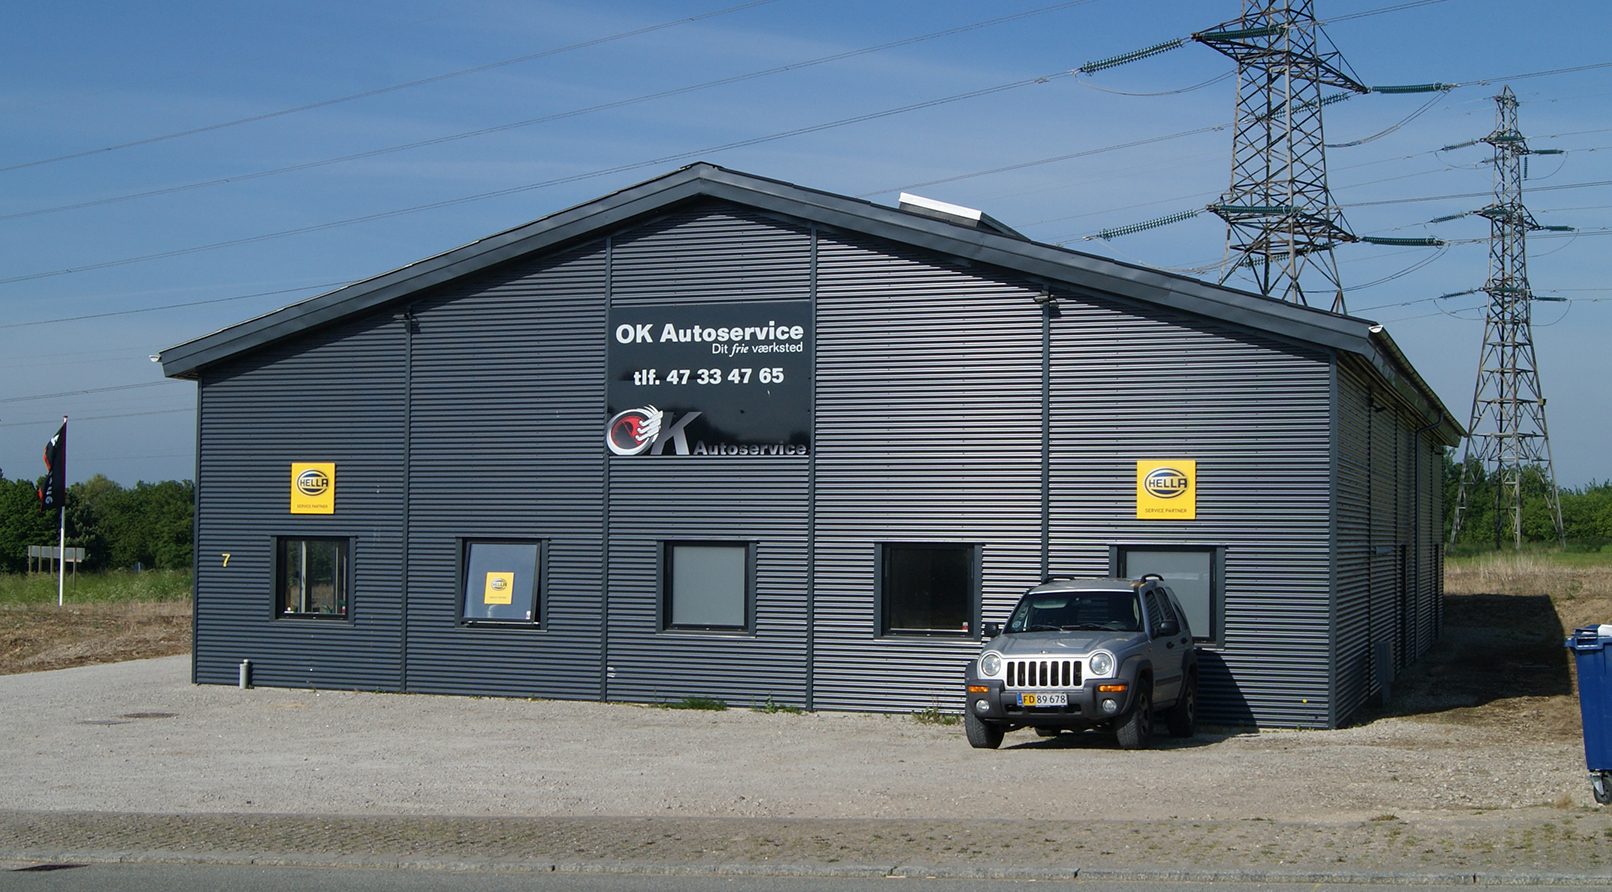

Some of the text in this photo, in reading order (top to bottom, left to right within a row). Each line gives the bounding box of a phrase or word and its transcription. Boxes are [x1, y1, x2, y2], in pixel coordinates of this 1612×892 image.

[616, 320, 804, 344] OK Autoservice
[712, 342, 803, 357] Dit frie værksted
[633, 367, 784, 386] tlf. 47 33 47 65
[606, 404, 702, 456] OK
[693, 440, 807, 456] Autoservice
[300, 478, 329, 488] HELLA
[1148, 478, 1188, 489] HELLA
[221, 553, 231, 567] 7
[1023, 695, 1066, 704] FD 89 678
